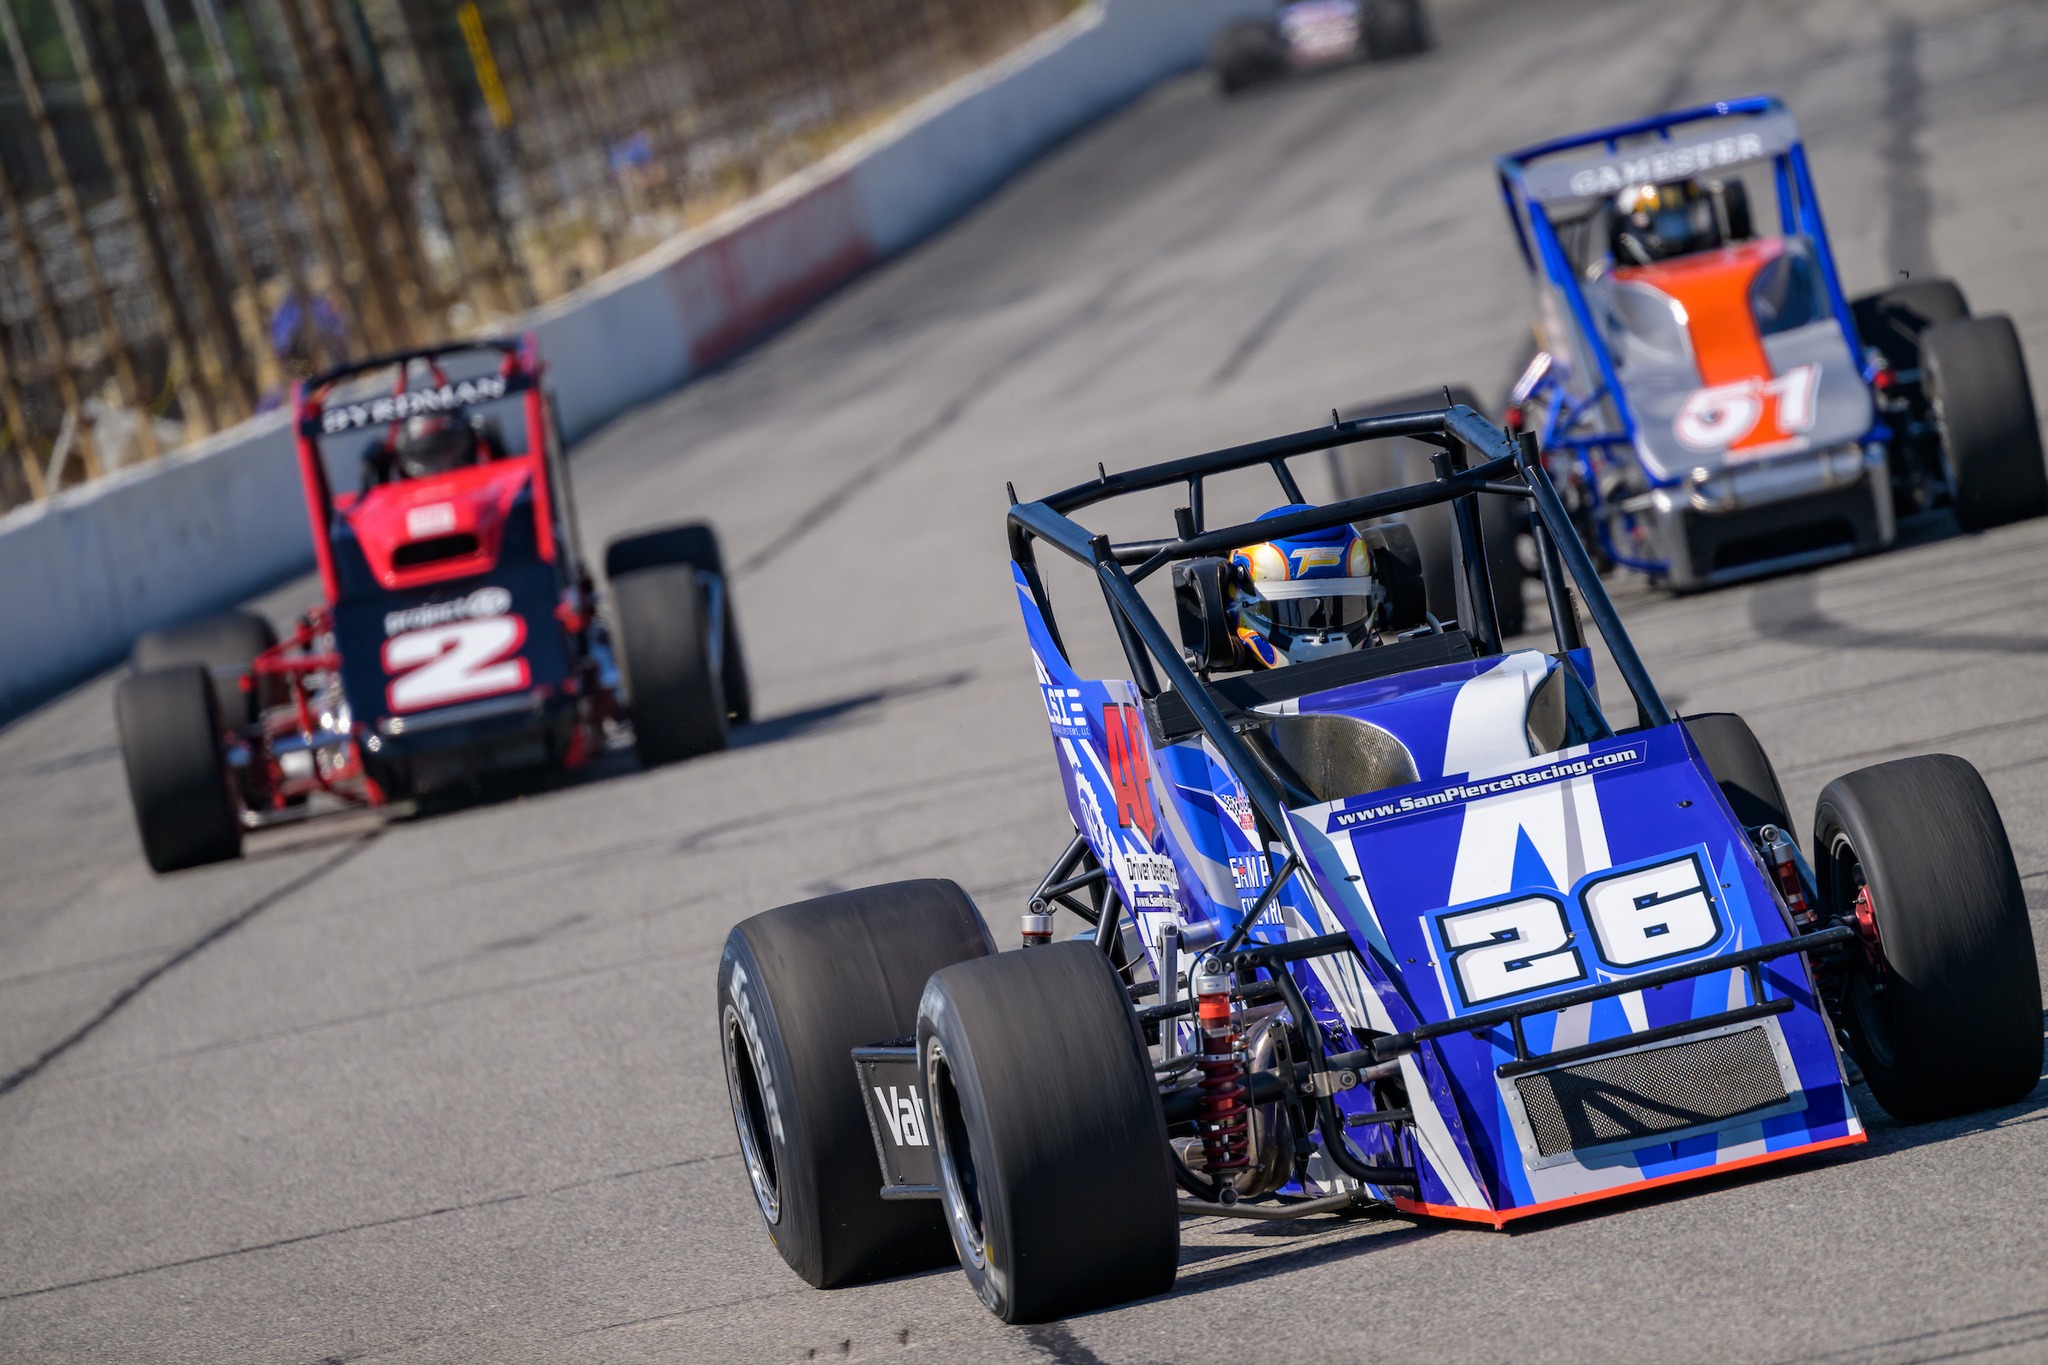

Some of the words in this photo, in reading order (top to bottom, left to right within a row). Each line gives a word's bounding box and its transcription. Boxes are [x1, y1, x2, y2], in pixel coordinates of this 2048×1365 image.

[1571, 133, 1763, 196] GAMESTER
[1289, 546, 1344, 578] TS
[381, 612, 531, 713] 2
[1336, 747, 1638, 827] www.SamPierceRacing.com
[1126, 855, 1150, 881] Driver
[1229, 855, 1260, 889] SAM
[1434, 850, 1726, 1008] 26
[874, 1084, 930, 1147] Val
